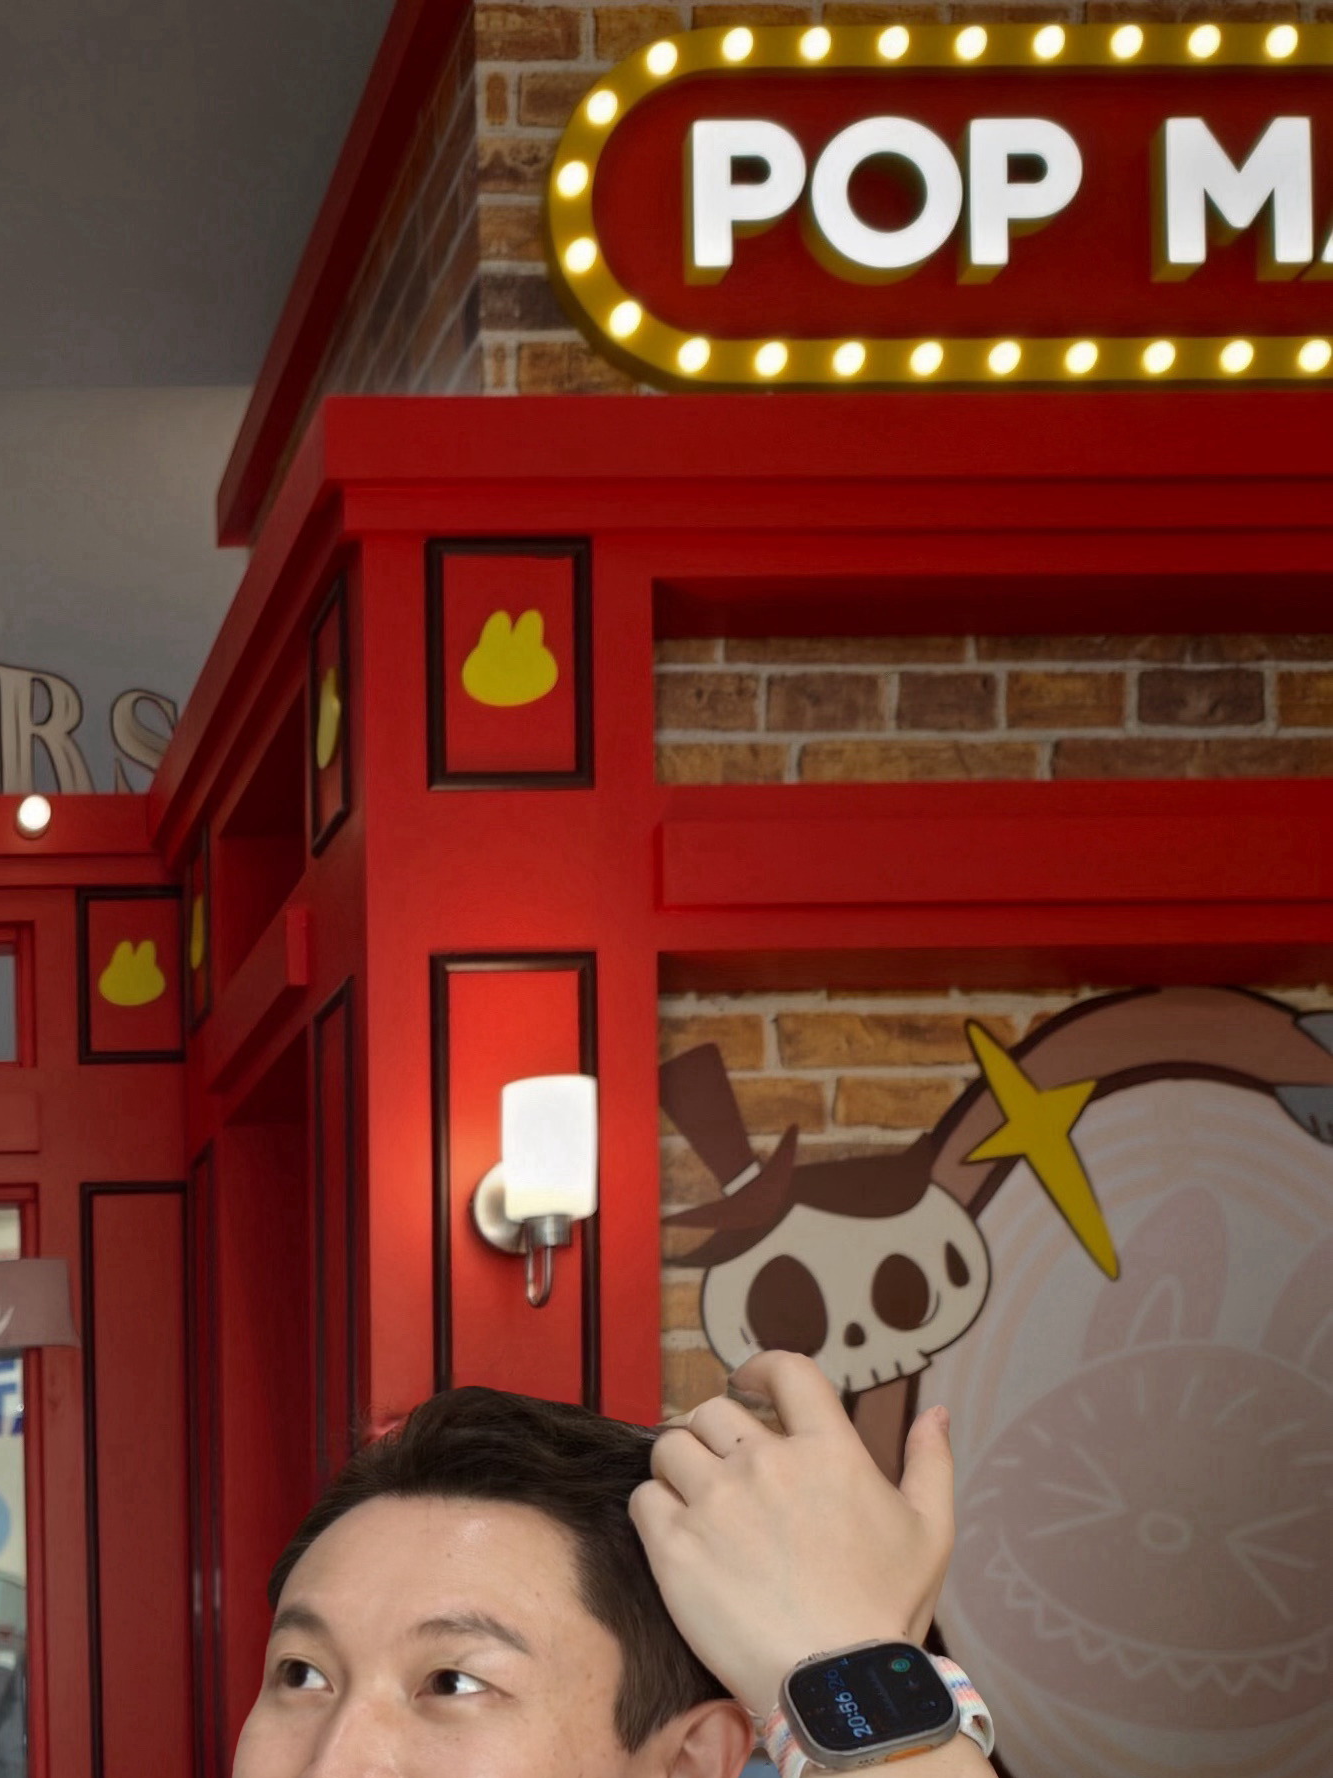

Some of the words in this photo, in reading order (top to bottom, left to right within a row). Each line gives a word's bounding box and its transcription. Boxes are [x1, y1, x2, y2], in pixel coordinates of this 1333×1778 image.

[688, 116, 1083, 272] POP
[1161, 115, 1333, 268] M
[834, 1691, 874, 1738] 20:56
